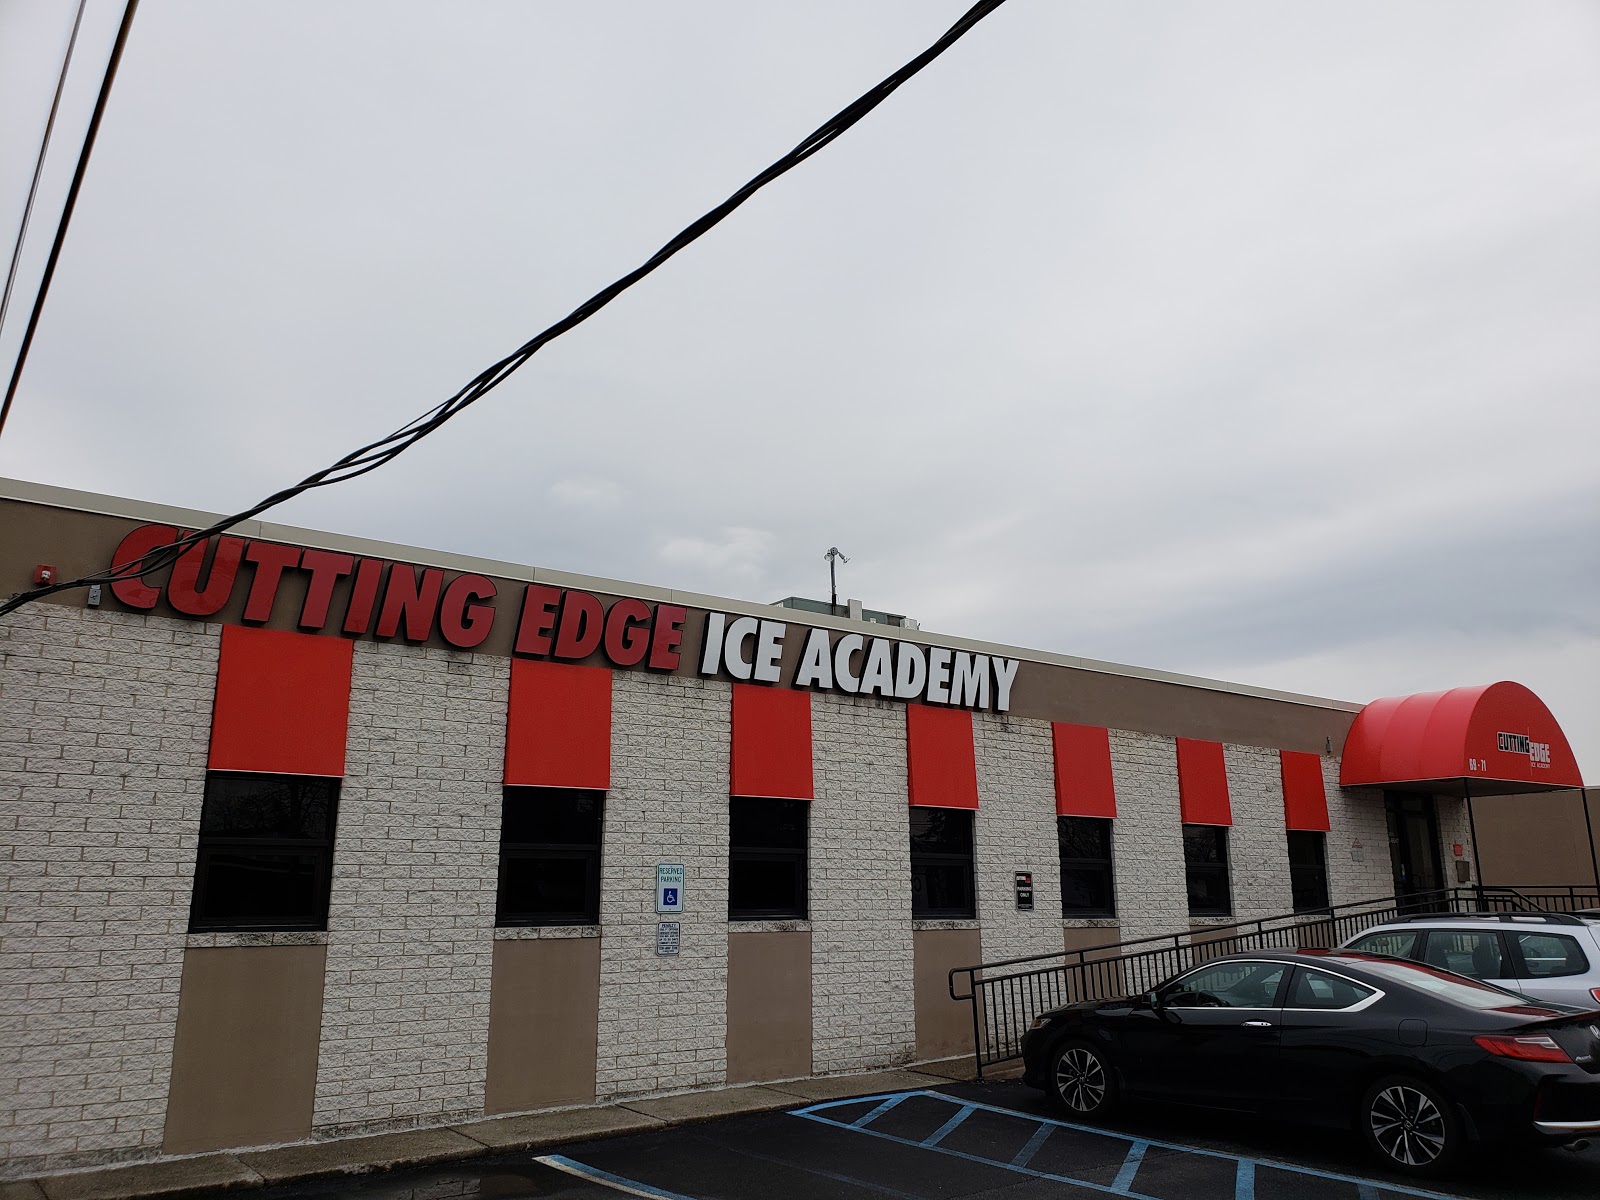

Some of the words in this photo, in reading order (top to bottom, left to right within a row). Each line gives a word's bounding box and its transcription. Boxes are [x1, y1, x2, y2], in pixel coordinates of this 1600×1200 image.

[109, 523, 498, 649] CUTTING
[514, 583, 688, 672] EDGE
[700, 611, 787, 683] ICE
[795, 627, 1020, 712] ACADEMY
[1498, 733, 1530, 753] CUTTING
[1529, 742, 1550, 763] EDGE
[659, 867, 682, 875] RESERVED
